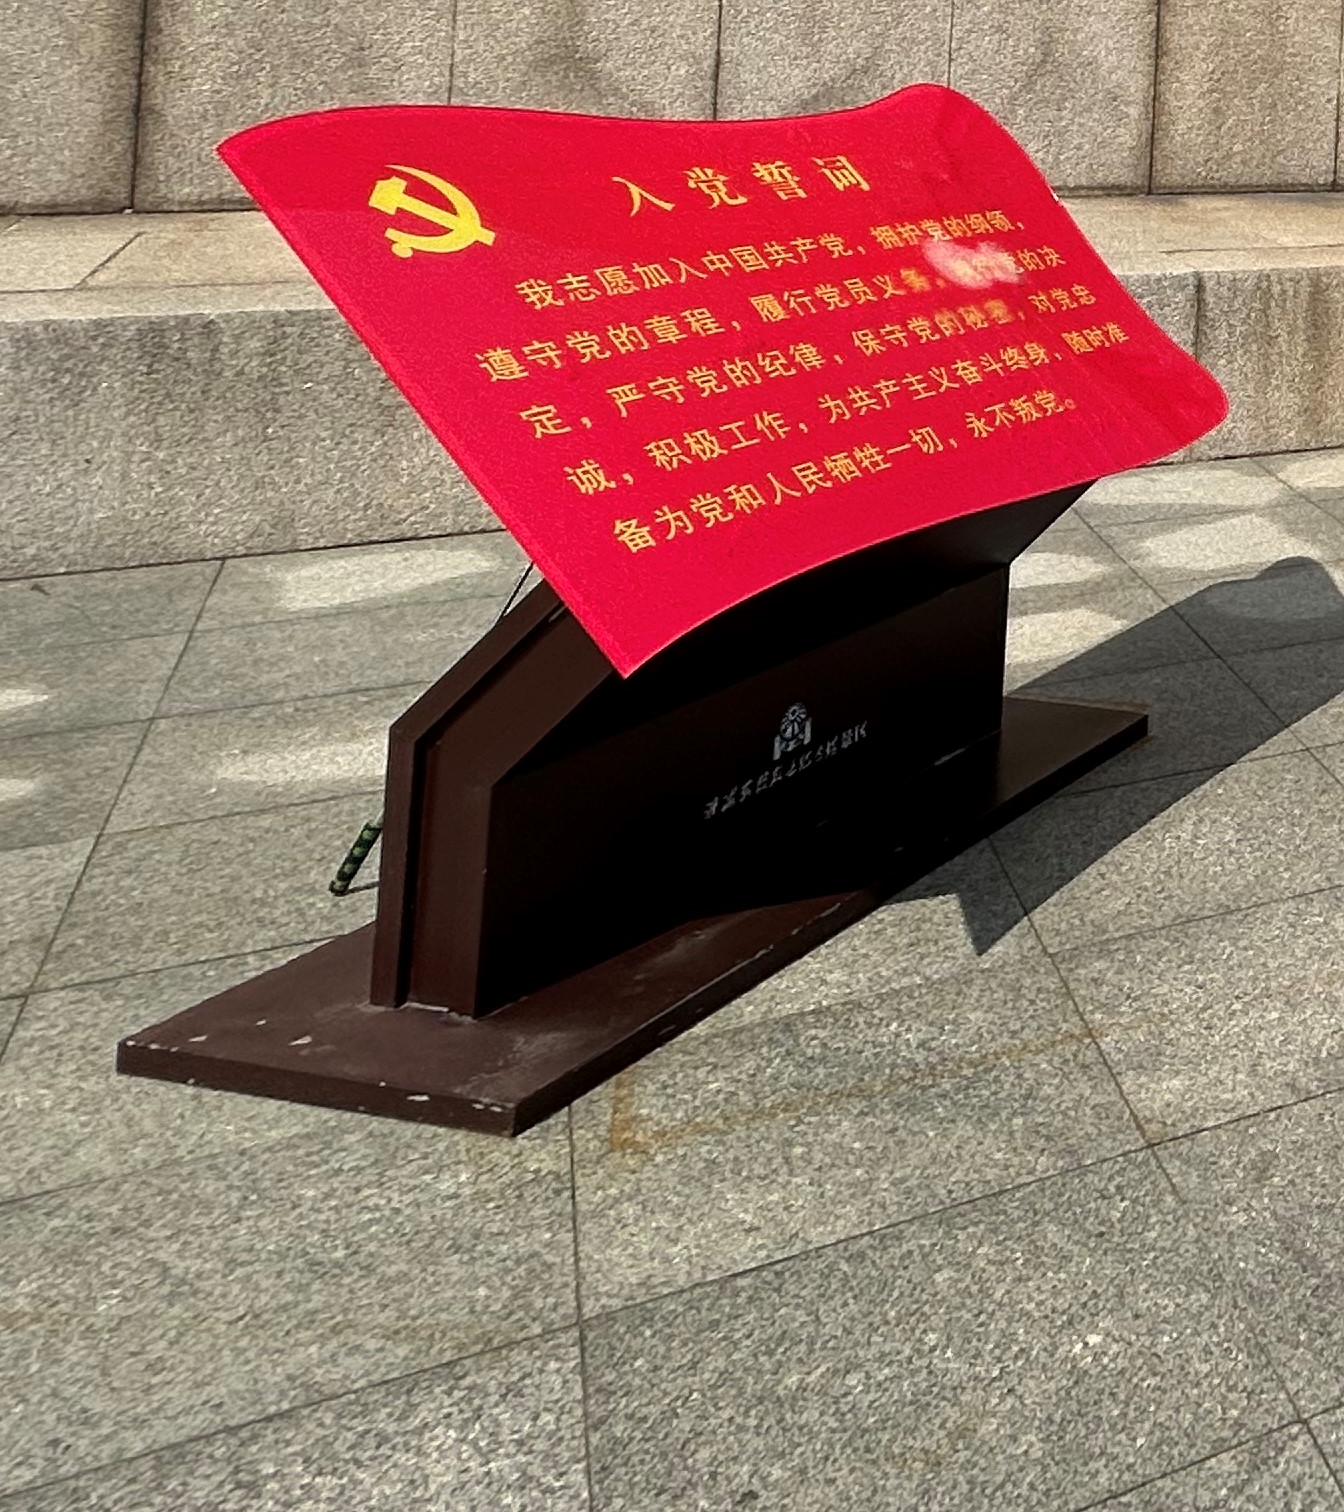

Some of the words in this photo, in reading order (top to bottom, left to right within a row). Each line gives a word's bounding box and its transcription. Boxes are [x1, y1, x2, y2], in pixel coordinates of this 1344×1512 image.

[611, 154, 870, 217] 入党誓词
[563, 321, 1130, 497] 诚，积极工作，为共产主义奋斗终身，随时准
[612, 388, 1077, 554] 备为党和人民牺牲一切，永不叛党。
